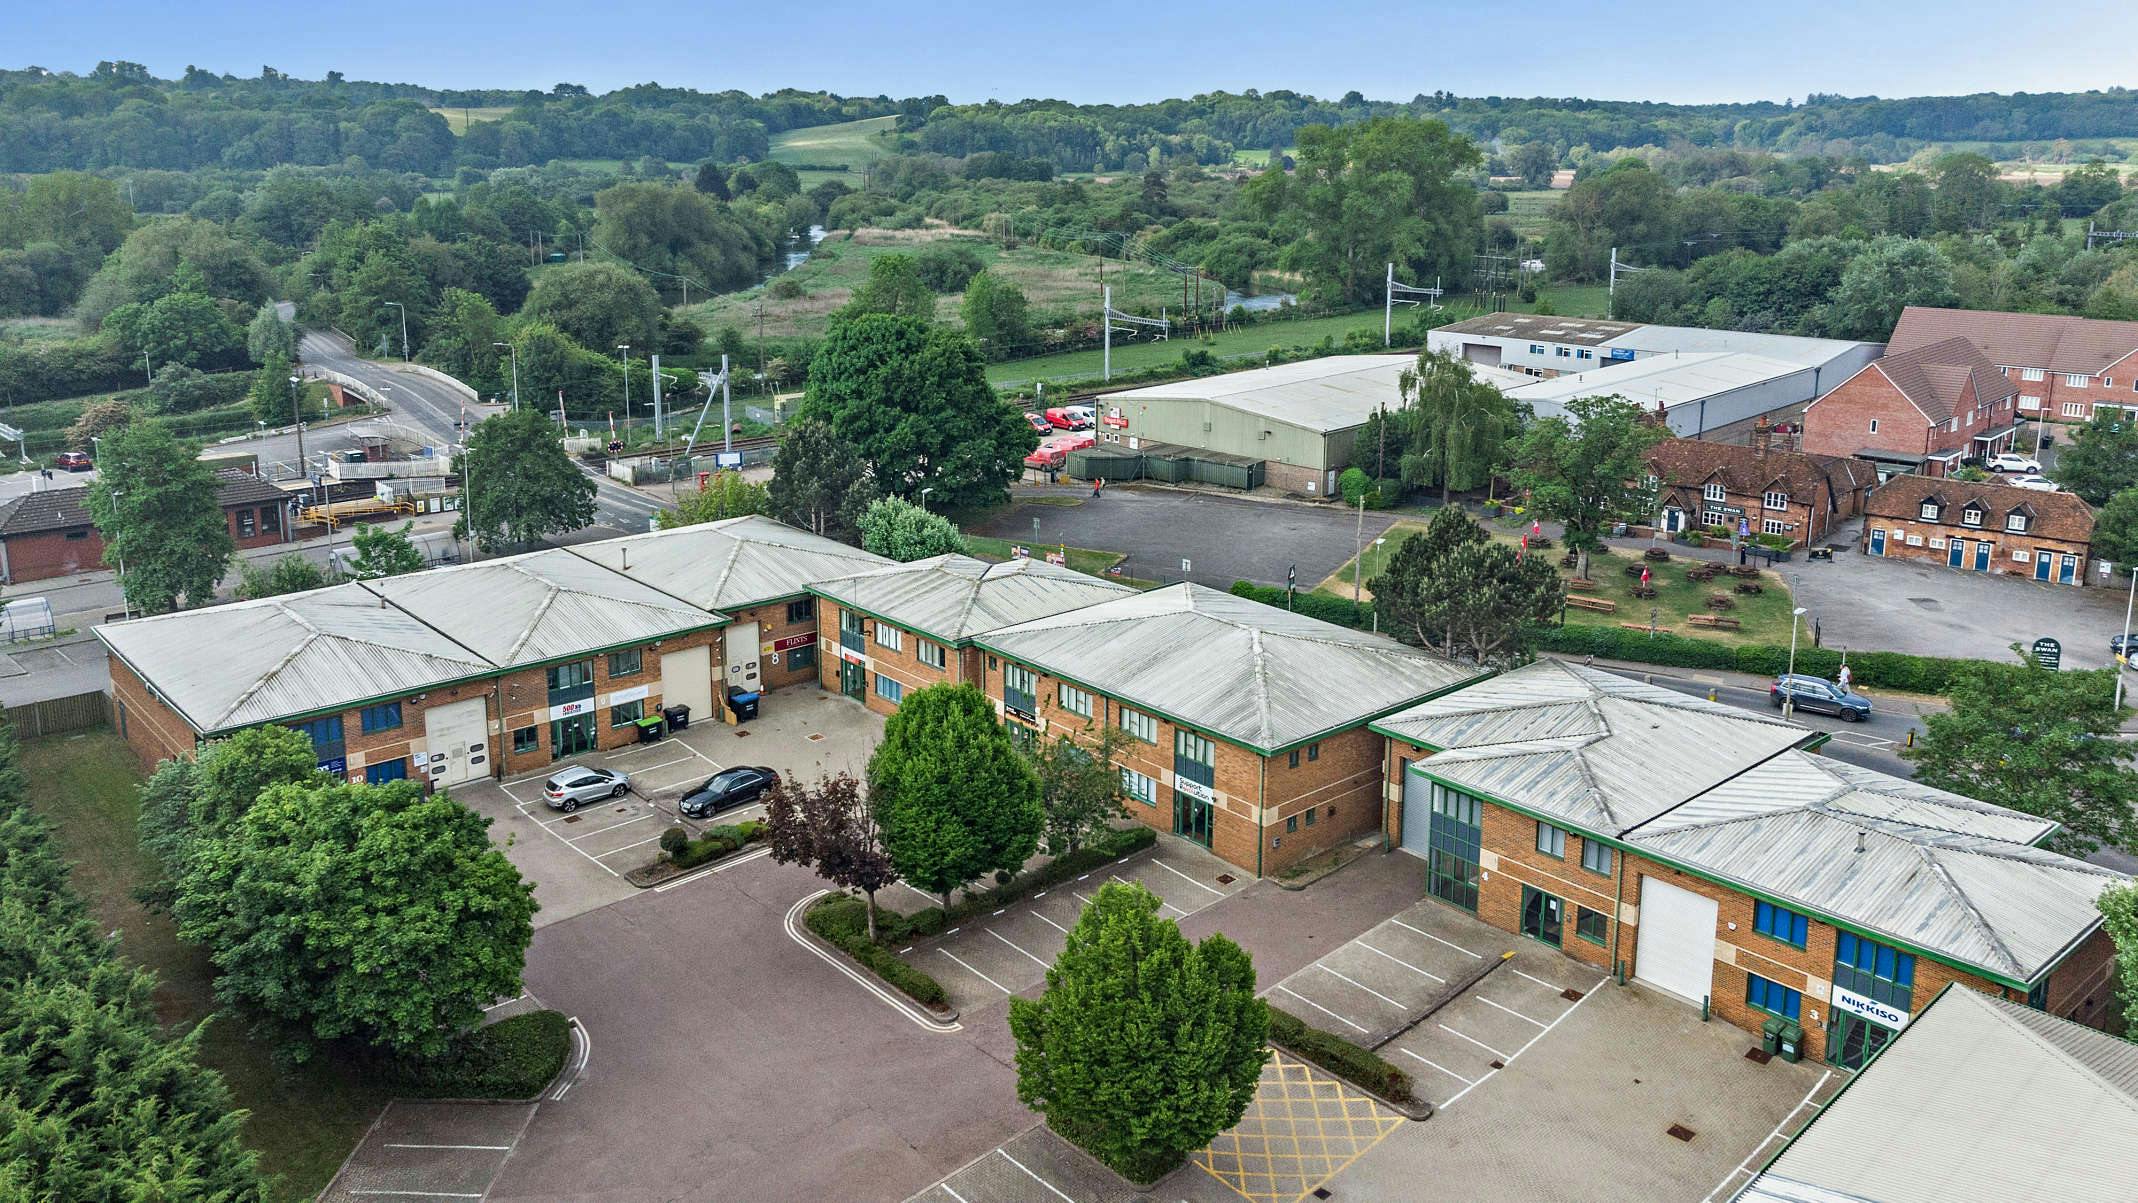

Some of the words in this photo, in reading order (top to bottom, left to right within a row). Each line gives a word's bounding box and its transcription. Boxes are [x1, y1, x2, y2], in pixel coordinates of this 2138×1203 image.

[786, 635, 808, 646] FLINTS
[772, 653, 779, 665] 8
[351, 774, 364, 784] 10
[1180, 777, 1202, 792] Support
[1481, 871, 1489, 881] 4
[1841, 995, 1899, 1022] NIKKISO
[1809, 1009, 1819, 1020] 3
